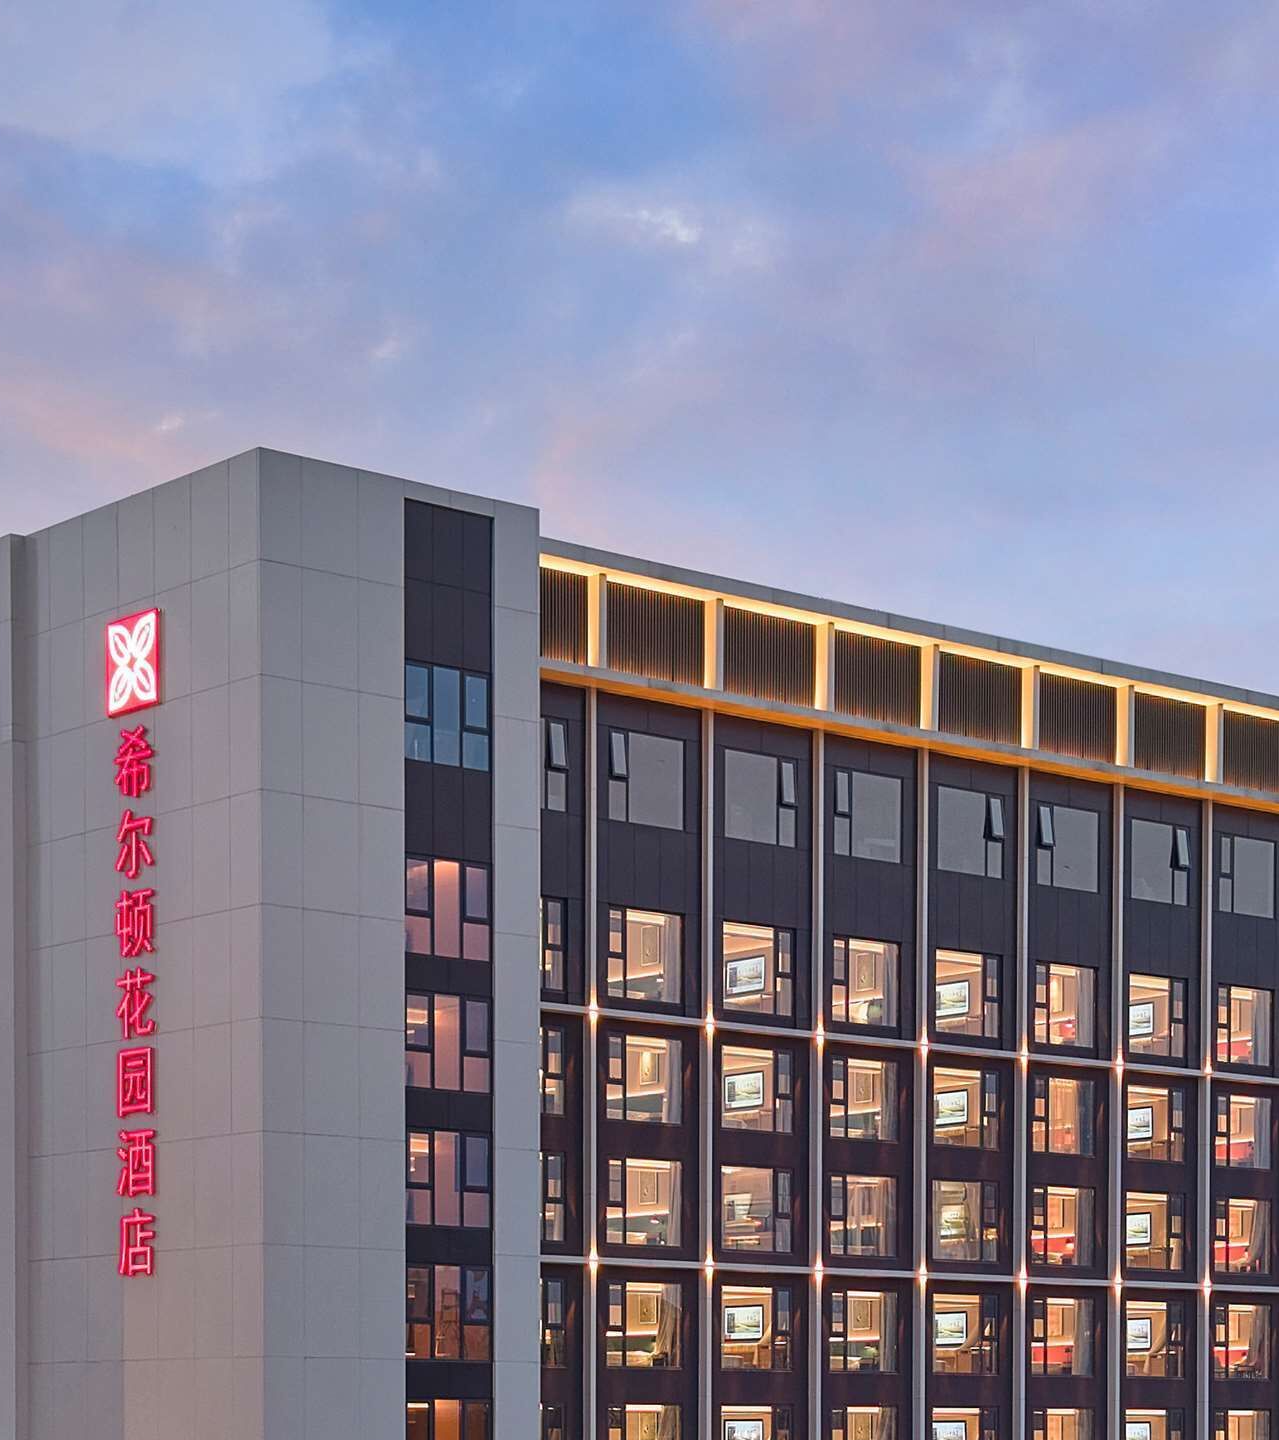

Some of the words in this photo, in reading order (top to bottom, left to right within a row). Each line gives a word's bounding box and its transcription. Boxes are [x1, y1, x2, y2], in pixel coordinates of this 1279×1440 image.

[114, 724, 157, 1276] 希尔顿花园酒店
